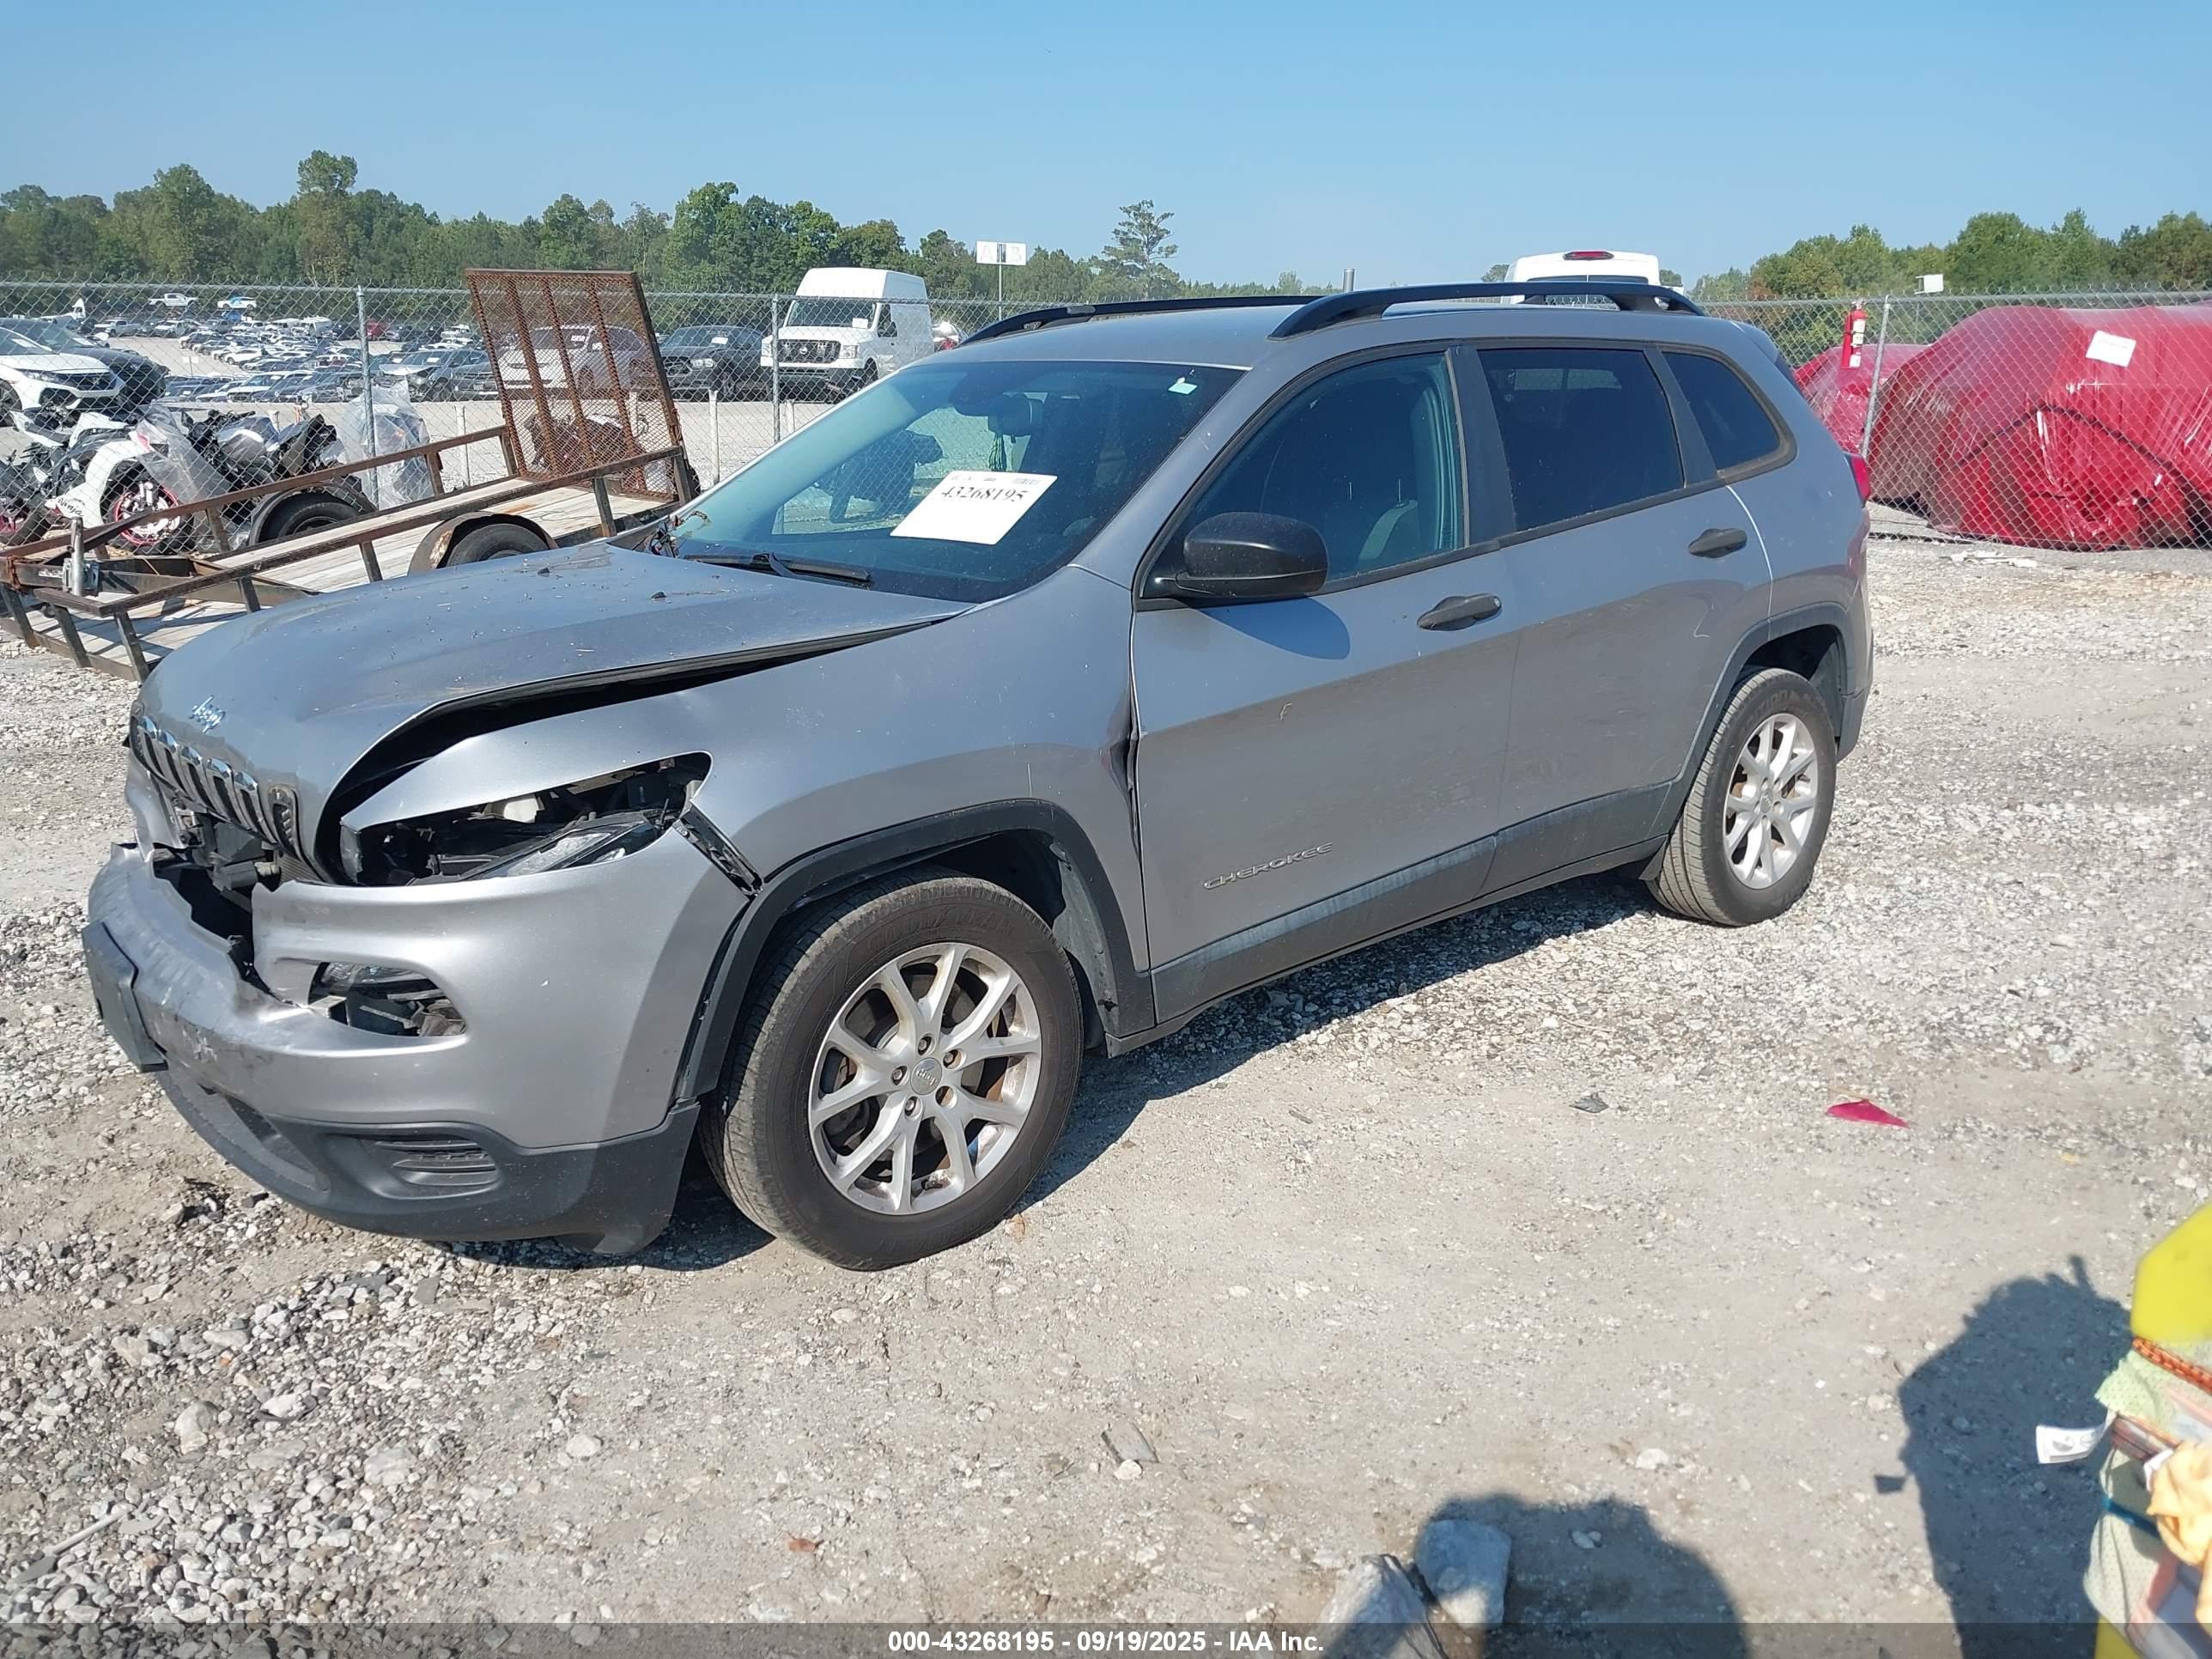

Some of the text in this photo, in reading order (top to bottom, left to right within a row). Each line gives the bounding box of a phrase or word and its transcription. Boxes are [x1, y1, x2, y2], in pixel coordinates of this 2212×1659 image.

[941, 485, 1030, 502] 43268195
[58, 497, 84, 517] Ninja
[1202, 841, 1334, 890] CHEROKEE
